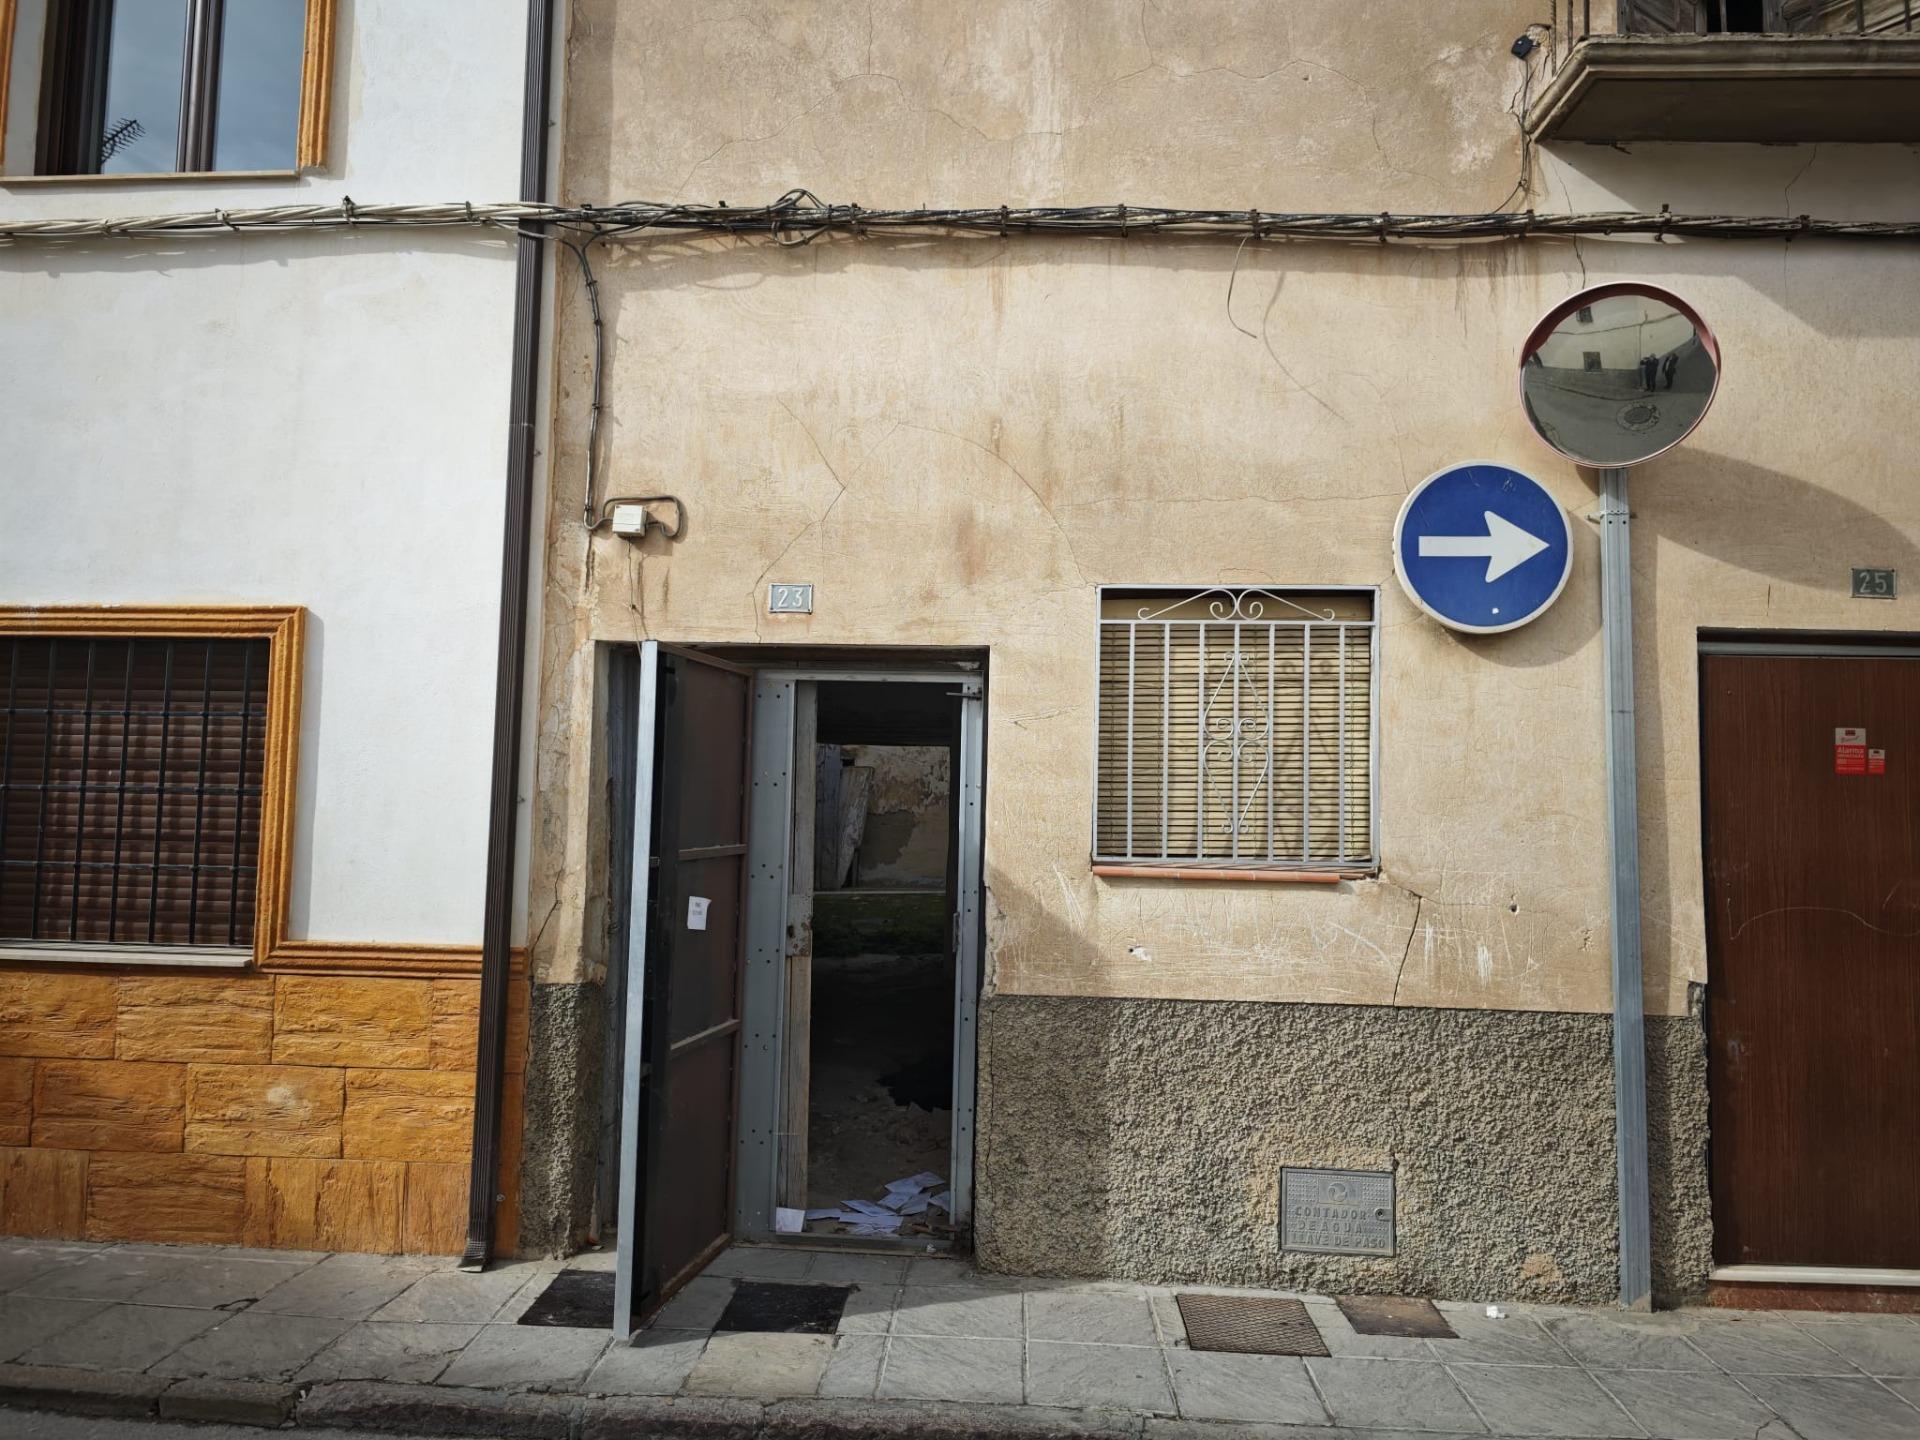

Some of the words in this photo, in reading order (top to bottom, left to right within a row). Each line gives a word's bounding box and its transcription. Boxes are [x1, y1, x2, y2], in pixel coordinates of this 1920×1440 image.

[1860, 572, 1887, 593] 25
[778, 587, 803, 607] 23
[1295, 1206, 1367, 1220] CONTADOR
[1291, 1233, 1329, 1246] LLAVE
[1334, 1236, 1350, 1247] DE
[1355, 1238, 1386, 1249] PASO
